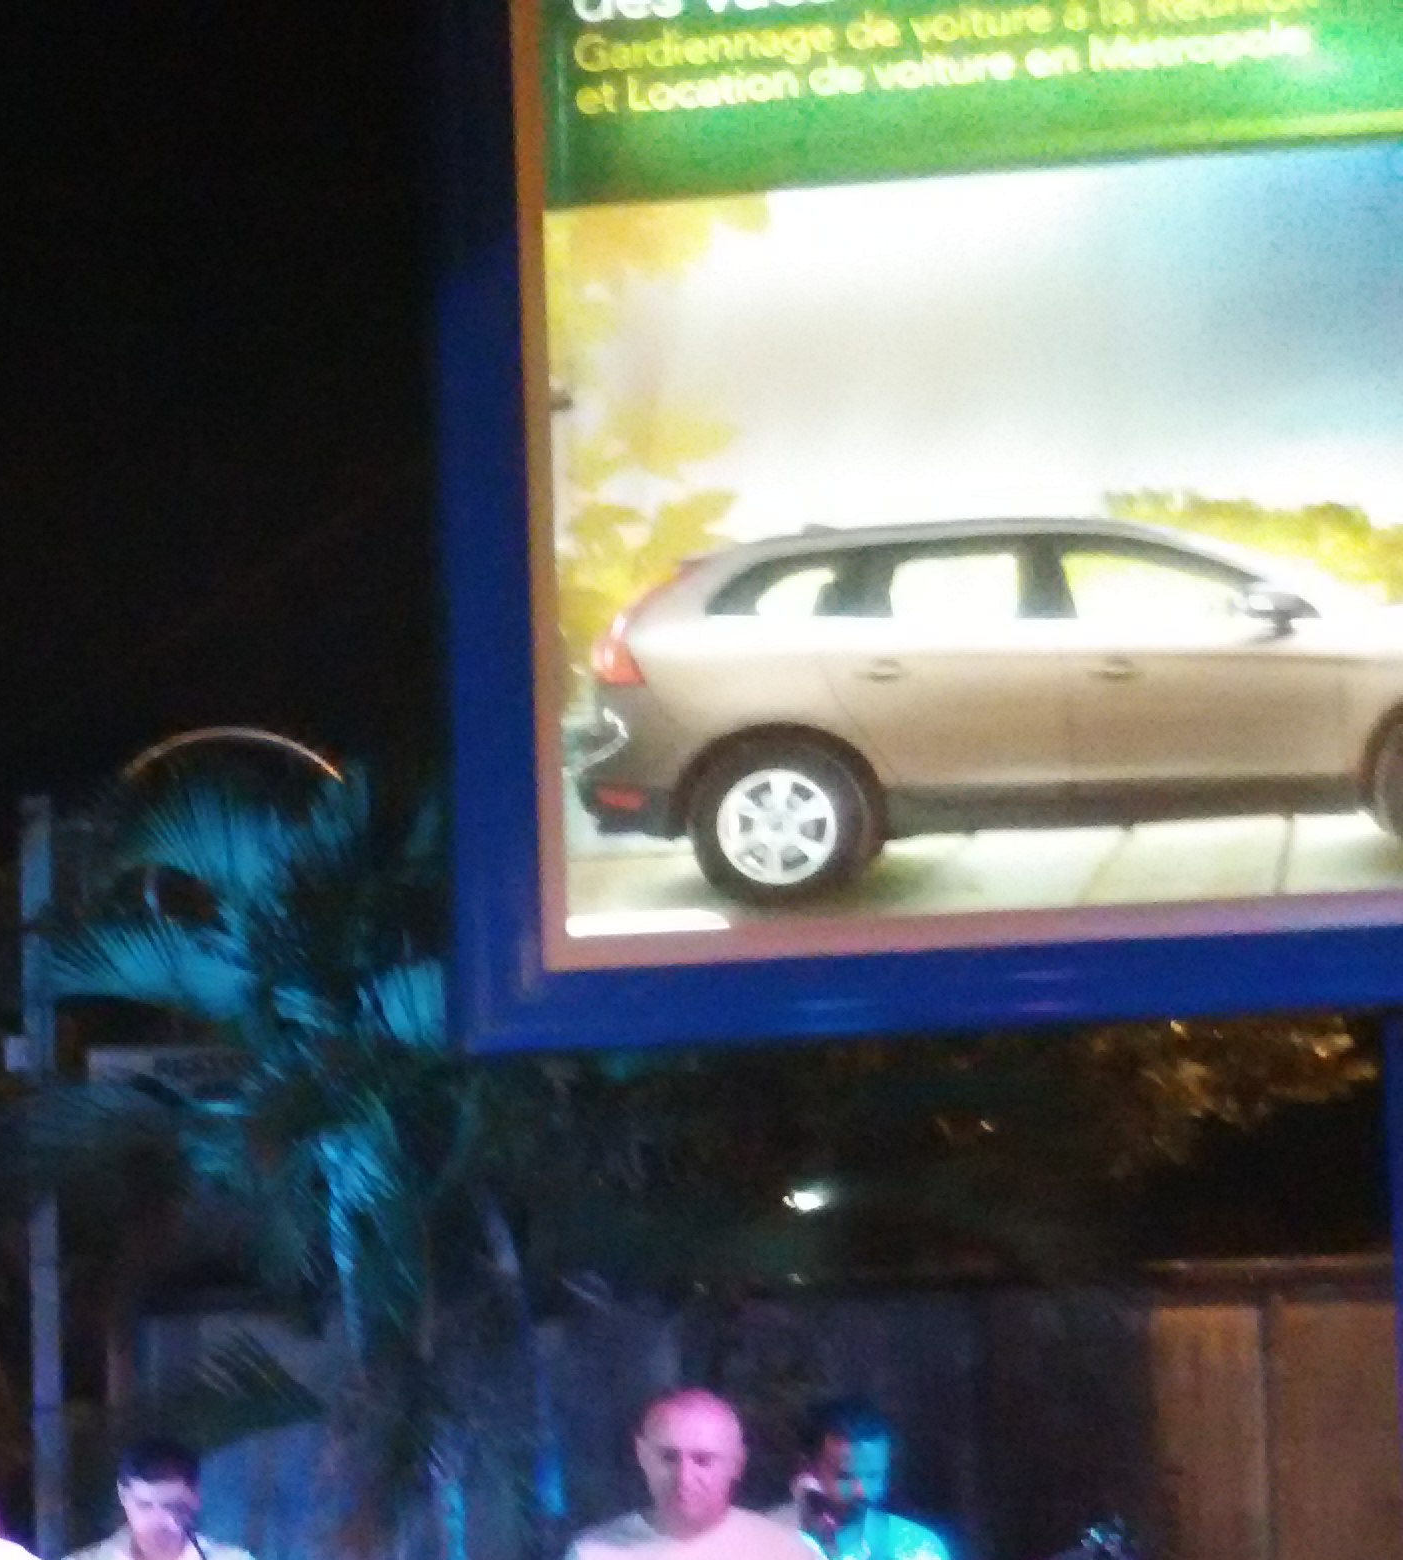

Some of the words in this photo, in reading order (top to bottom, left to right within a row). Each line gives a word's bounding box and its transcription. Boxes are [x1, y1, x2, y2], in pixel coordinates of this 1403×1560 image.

[845, 10, 901, 49] de
[908, 6, 1053, 43] voiture
[627, 70, 800, 113] Location
[807, 56, 867, 96] de
[872, 50, 1015, 90] voiture
[1024, 45, 1080, 79] en
